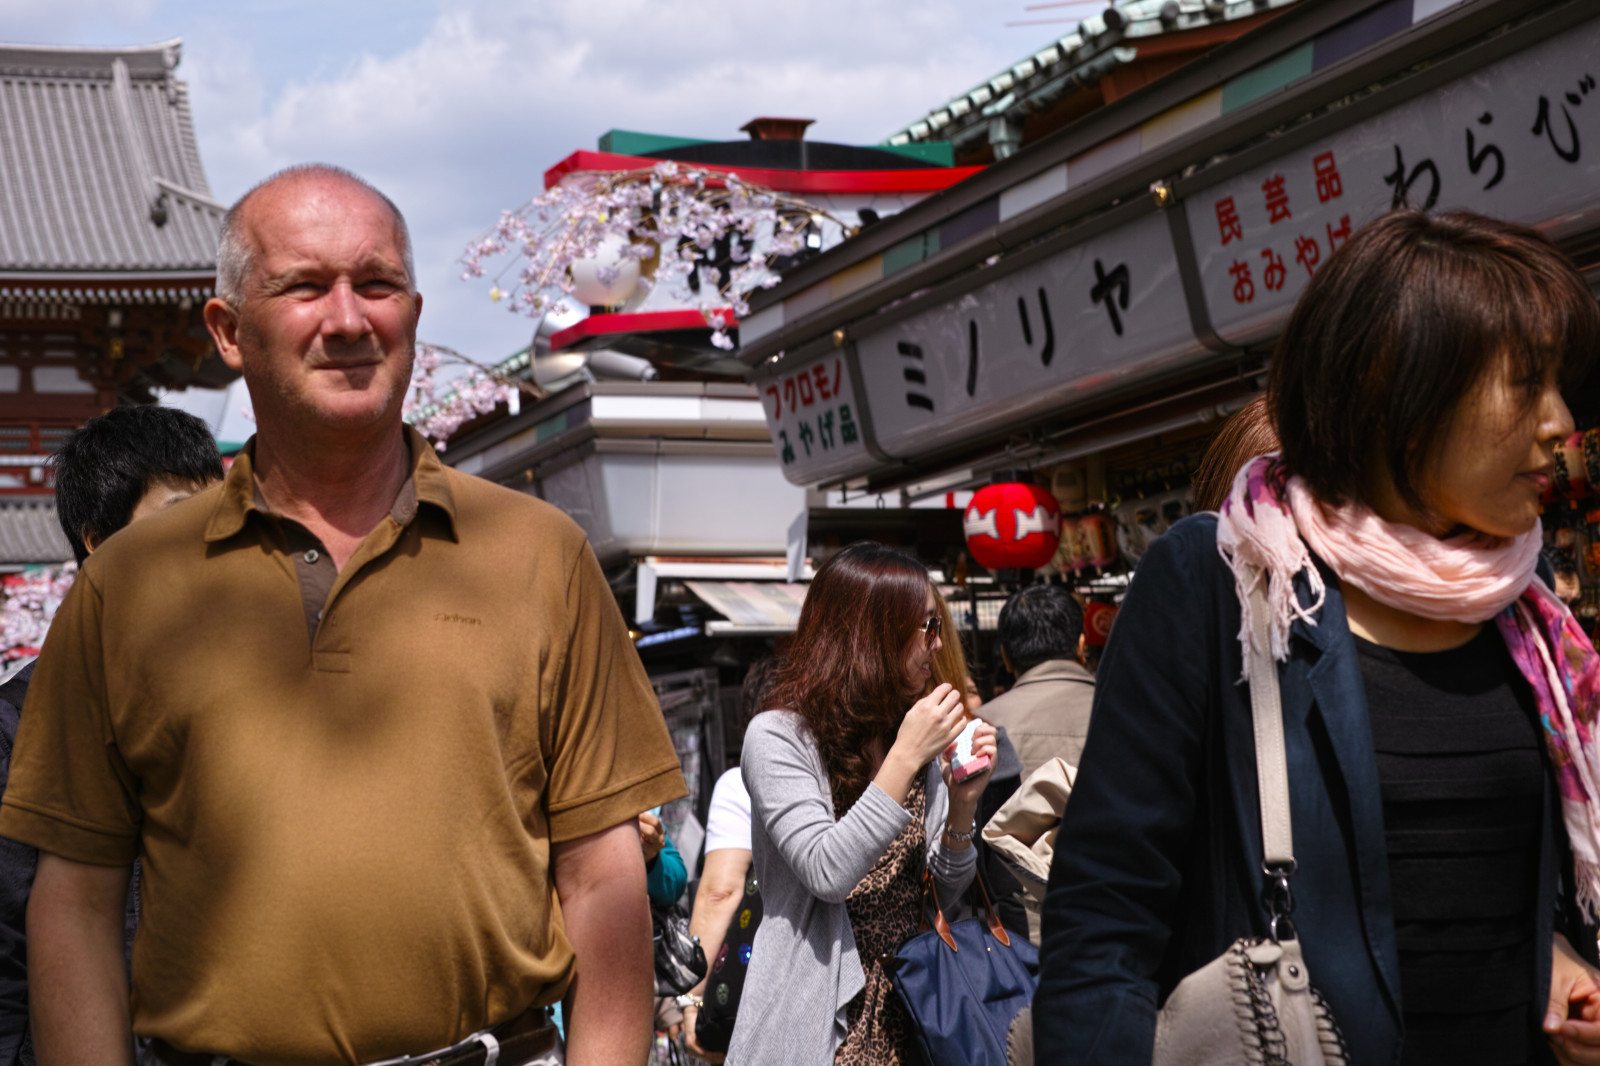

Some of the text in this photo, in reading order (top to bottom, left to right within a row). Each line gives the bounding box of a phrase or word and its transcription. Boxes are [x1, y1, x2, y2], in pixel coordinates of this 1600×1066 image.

[1383, 73, 1596, 211] わらび
[1215, 150, 1343, 247] 民芸品
[897, 257, 1130, 413] ミノリヤ
[766, 358, 841, 420] フクロモノ
[778, 402, 858, 466] みやげ品
